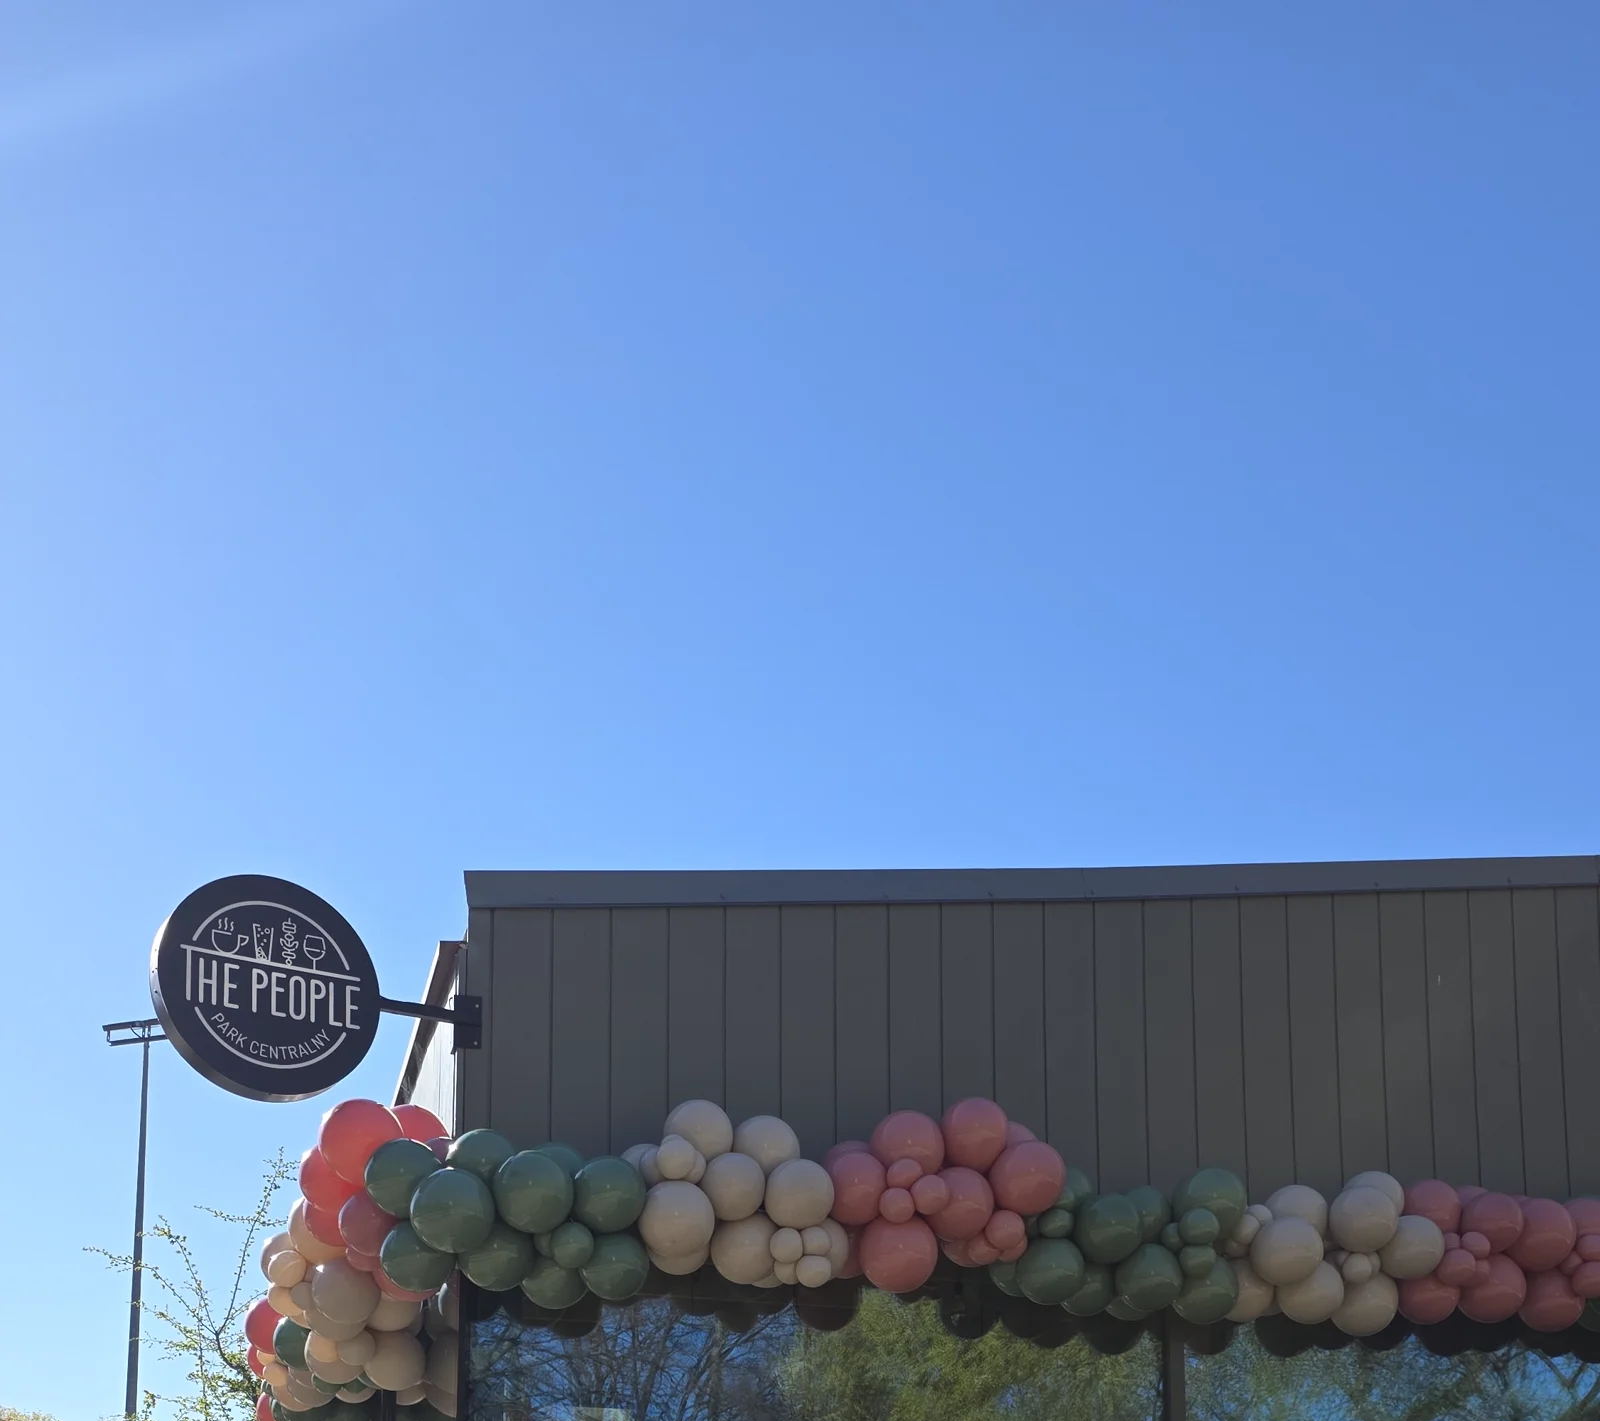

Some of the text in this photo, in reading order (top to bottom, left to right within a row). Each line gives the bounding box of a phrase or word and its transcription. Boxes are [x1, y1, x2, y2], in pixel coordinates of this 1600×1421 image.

[185, 946, 361, 1030] THE PEOPLE
[211, 1012, 331, 1060] PARK CENTRALNY
